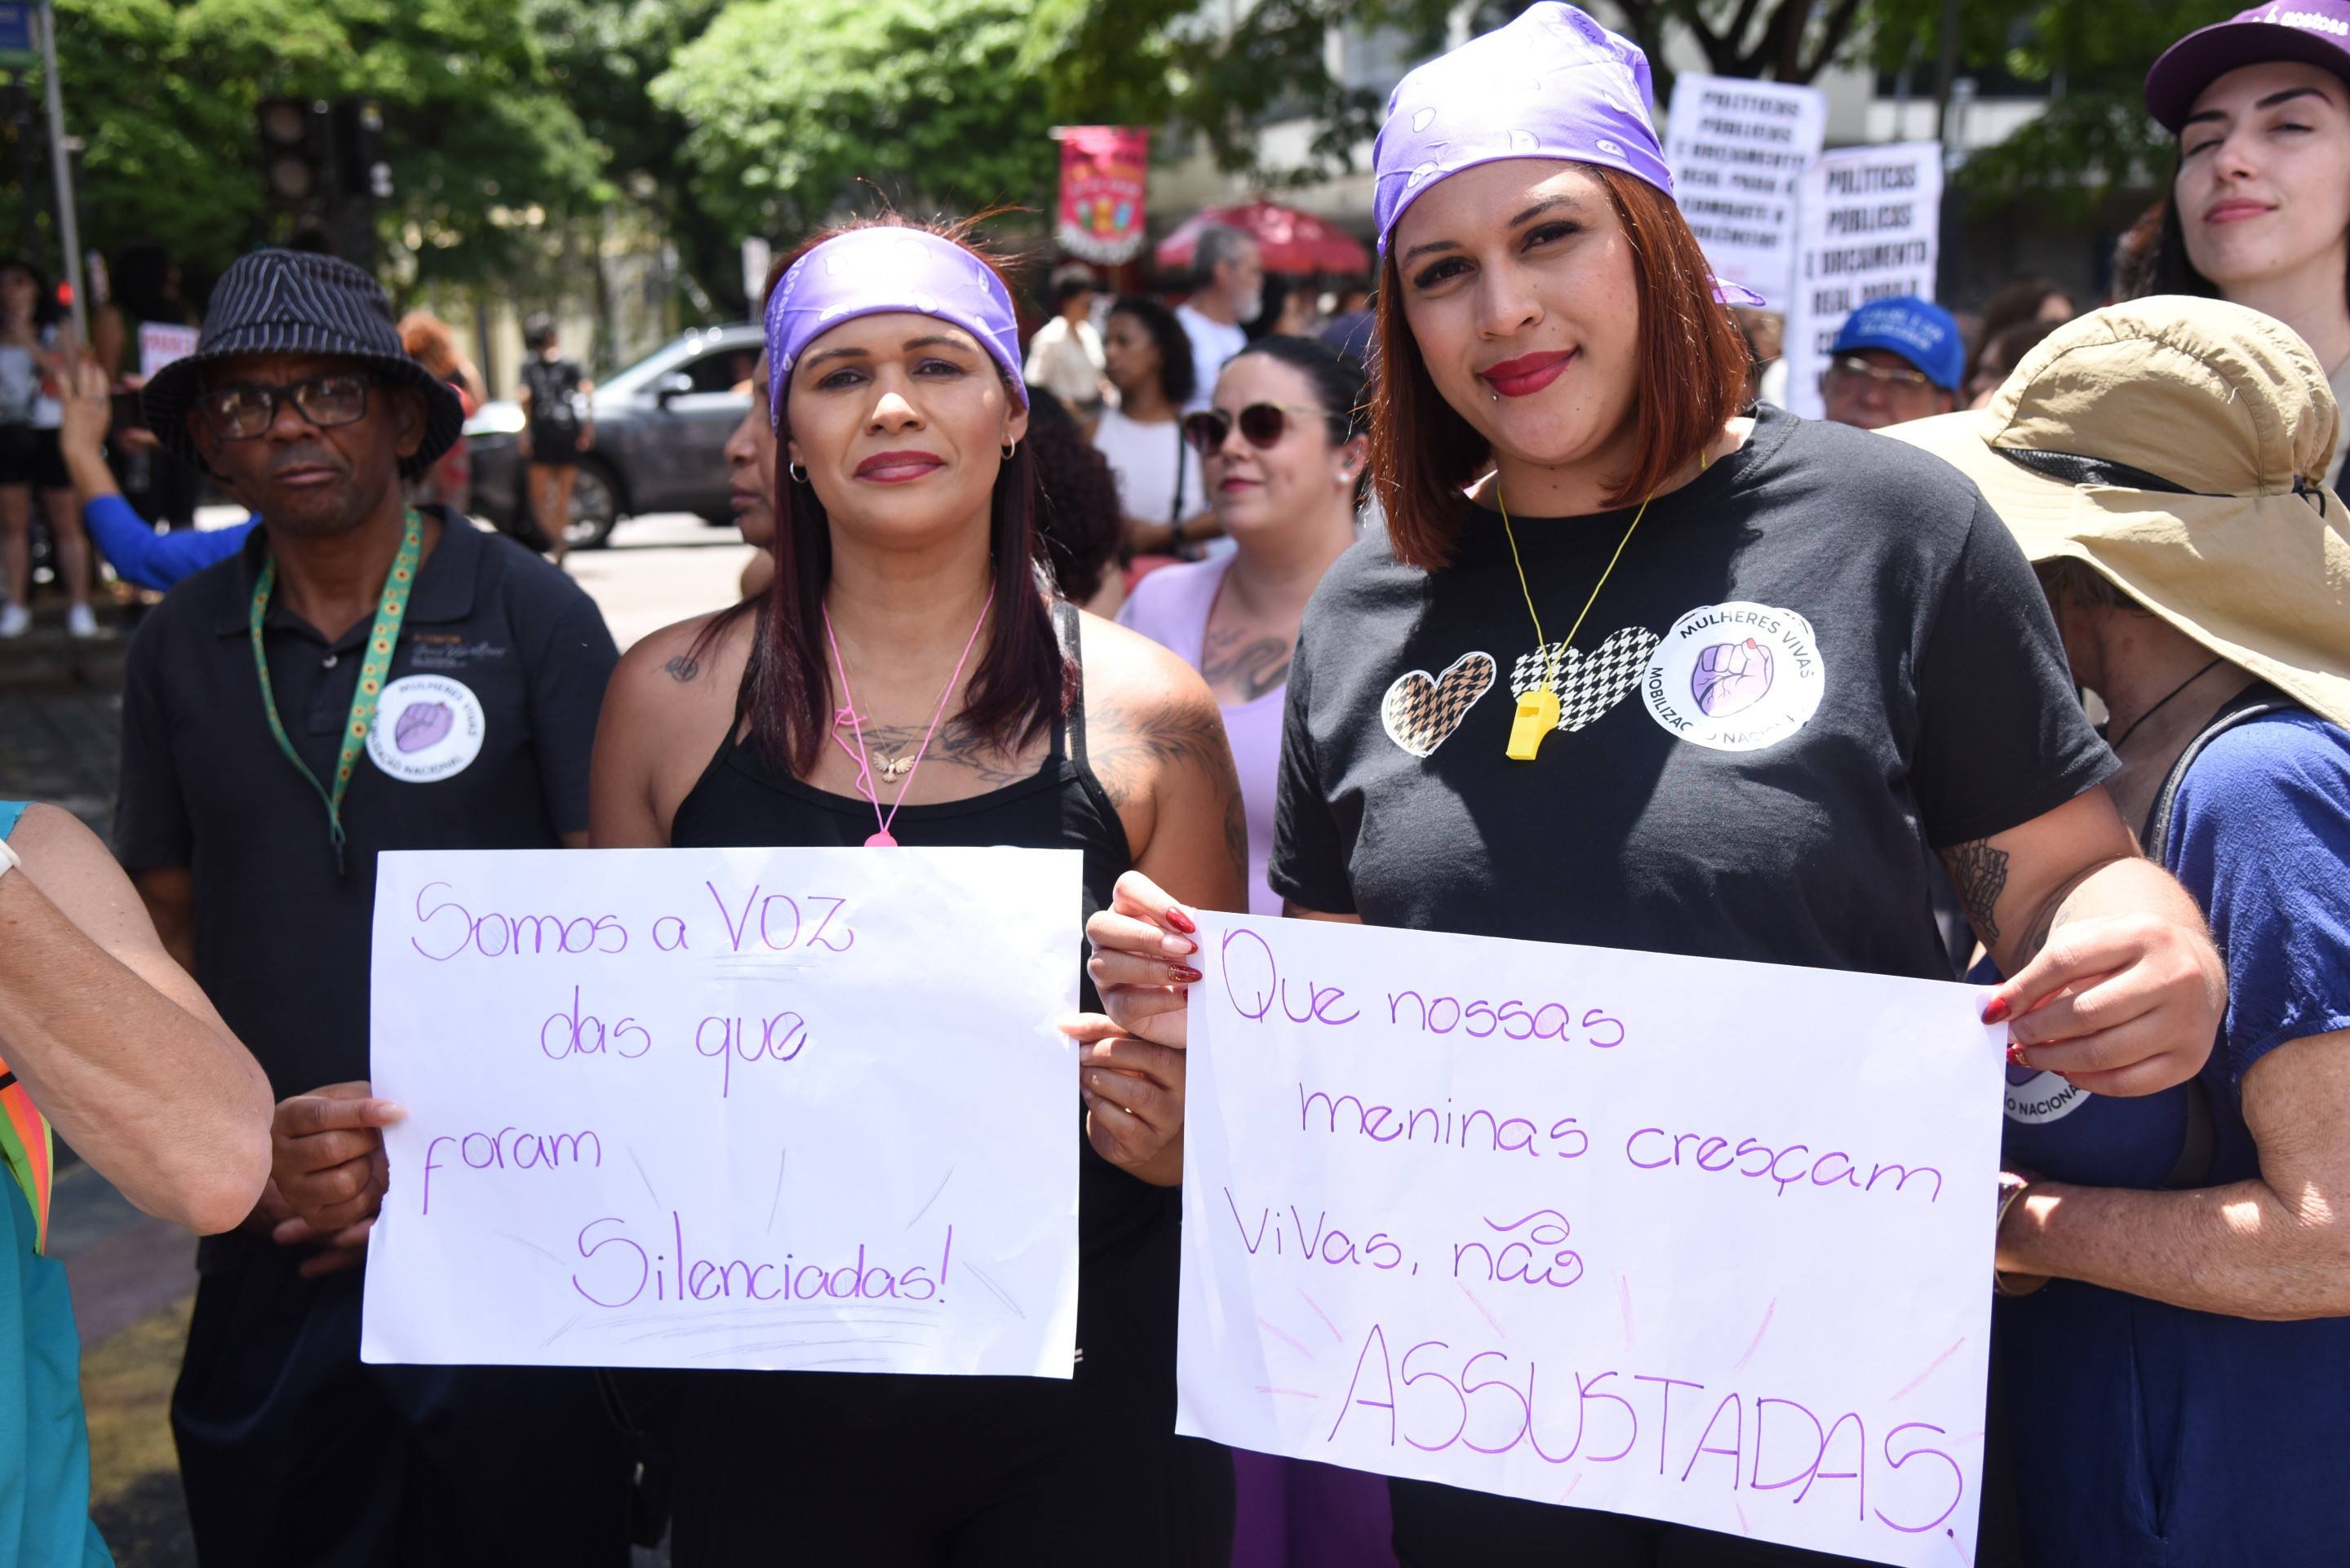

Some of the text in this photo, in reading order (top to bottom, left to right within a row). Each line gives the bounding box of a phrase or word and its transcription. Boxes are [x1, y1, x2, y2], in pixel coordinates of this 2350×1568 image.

[1679, 611, 1815, 679] MULHERES VIVAS
[412, 881, 627, 961] Somos
[652, 915, 690, 952] a
[1222, 928, 1625, 1048] Que nossas
[541, 985, 808, 1098] das que
[1300, 1082, 1943, 1203] meninas cresçam
[2019, 1083, 2081, 1116] NACIONA
[422, 1127, 602, 1215] foram
[571, 1210, 953, 1307] Silenciadas!
[1453, 1207, 1585, 1288] não
[1328, 1323, 1965, 1539] ASSUSTADAS.
